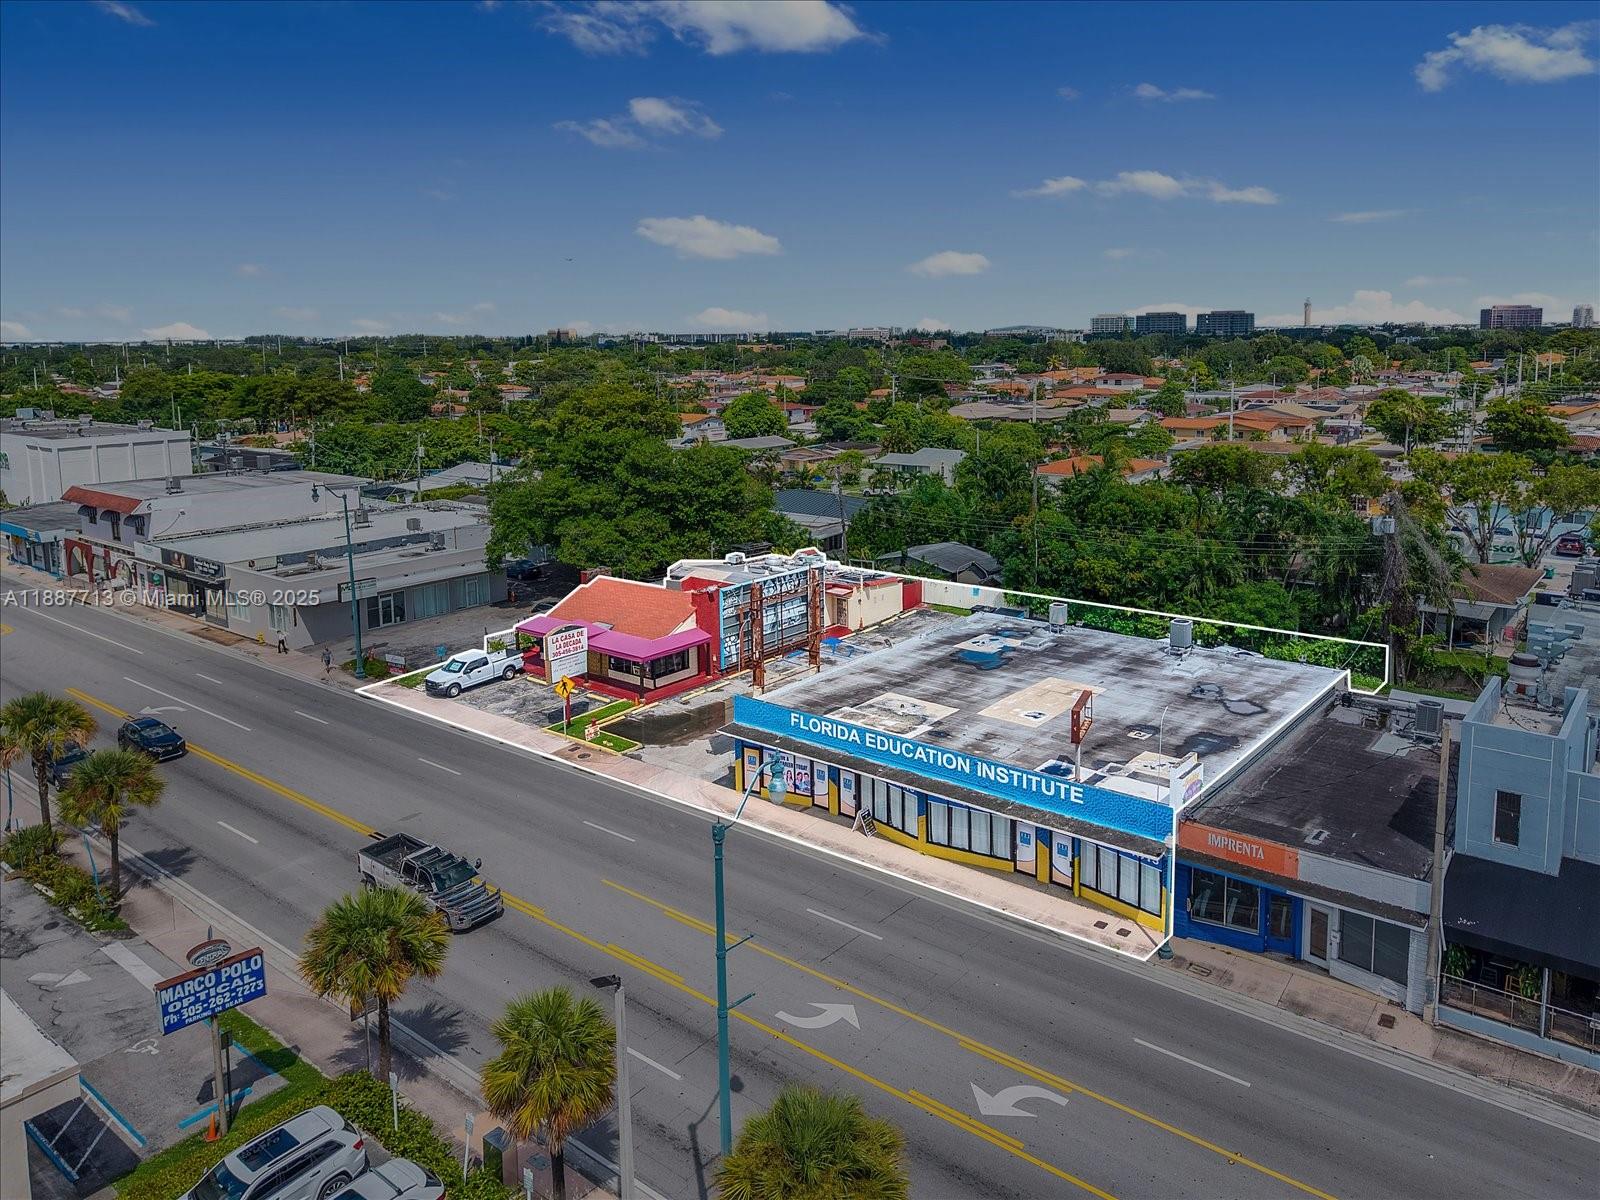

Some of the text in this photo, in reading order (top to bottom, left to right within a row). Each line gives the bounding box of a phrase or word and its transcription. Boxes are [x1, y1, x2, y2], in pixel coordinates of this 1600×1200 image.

[560, 633, 575, 641] CASA
[790, 712, 1084, 805] FLORIDA EDUCATION INSTITUTE
[1208, 832, 1264, 860] IMPRENTA
[160, 955, 262, 1005] MARCO POLO
[167, 975, 256, 1013] OPTICAL
[163, 979, 264, 1027] Ph: 305-262-7273
